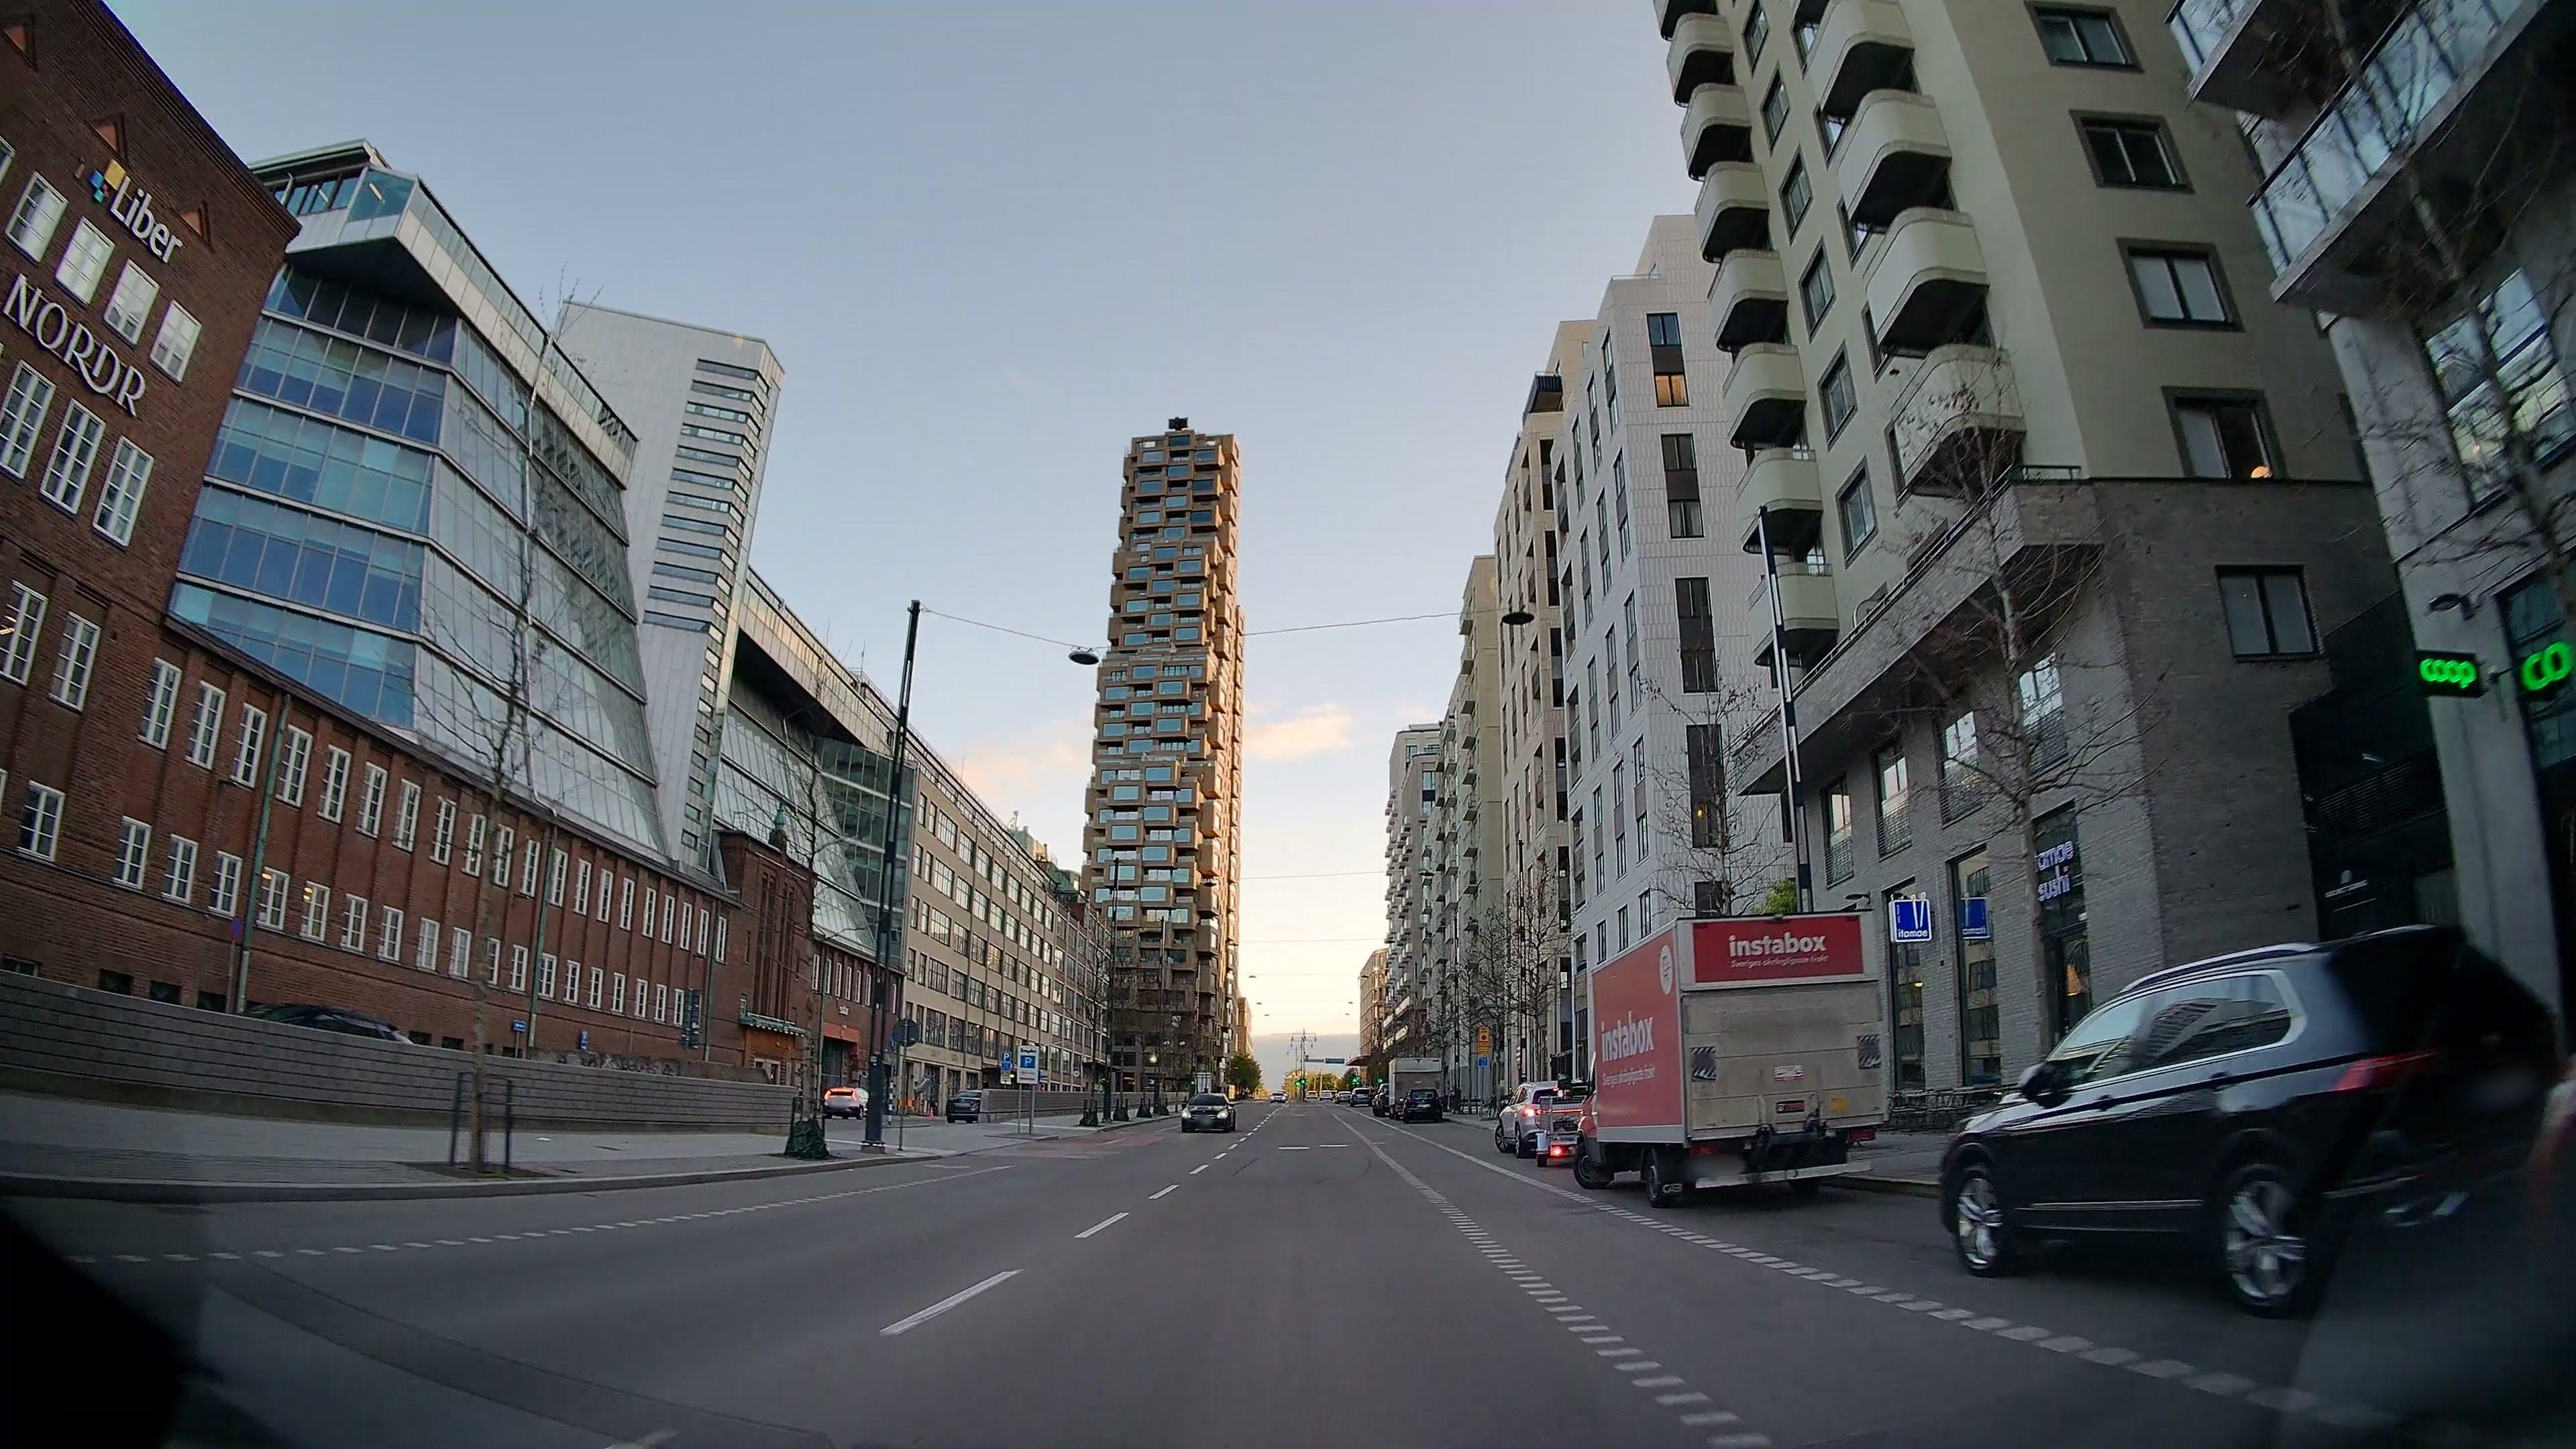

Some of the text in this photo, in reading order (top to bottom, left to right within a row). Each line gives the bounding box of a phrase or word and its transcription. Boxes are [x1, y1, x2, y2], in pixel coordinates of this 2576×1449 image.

[110, 176, 182, 264] Liber
[3, 274, 146, 416] NORDR
[2420, 658, 2477, 688] coop
[2038, 865, 2070, 901] sushi
[1729, 932, 1827, 957] instabox
[1898, 928, 1929, 938] itamae
[1601, 1010, 1654, 1062] instabox
